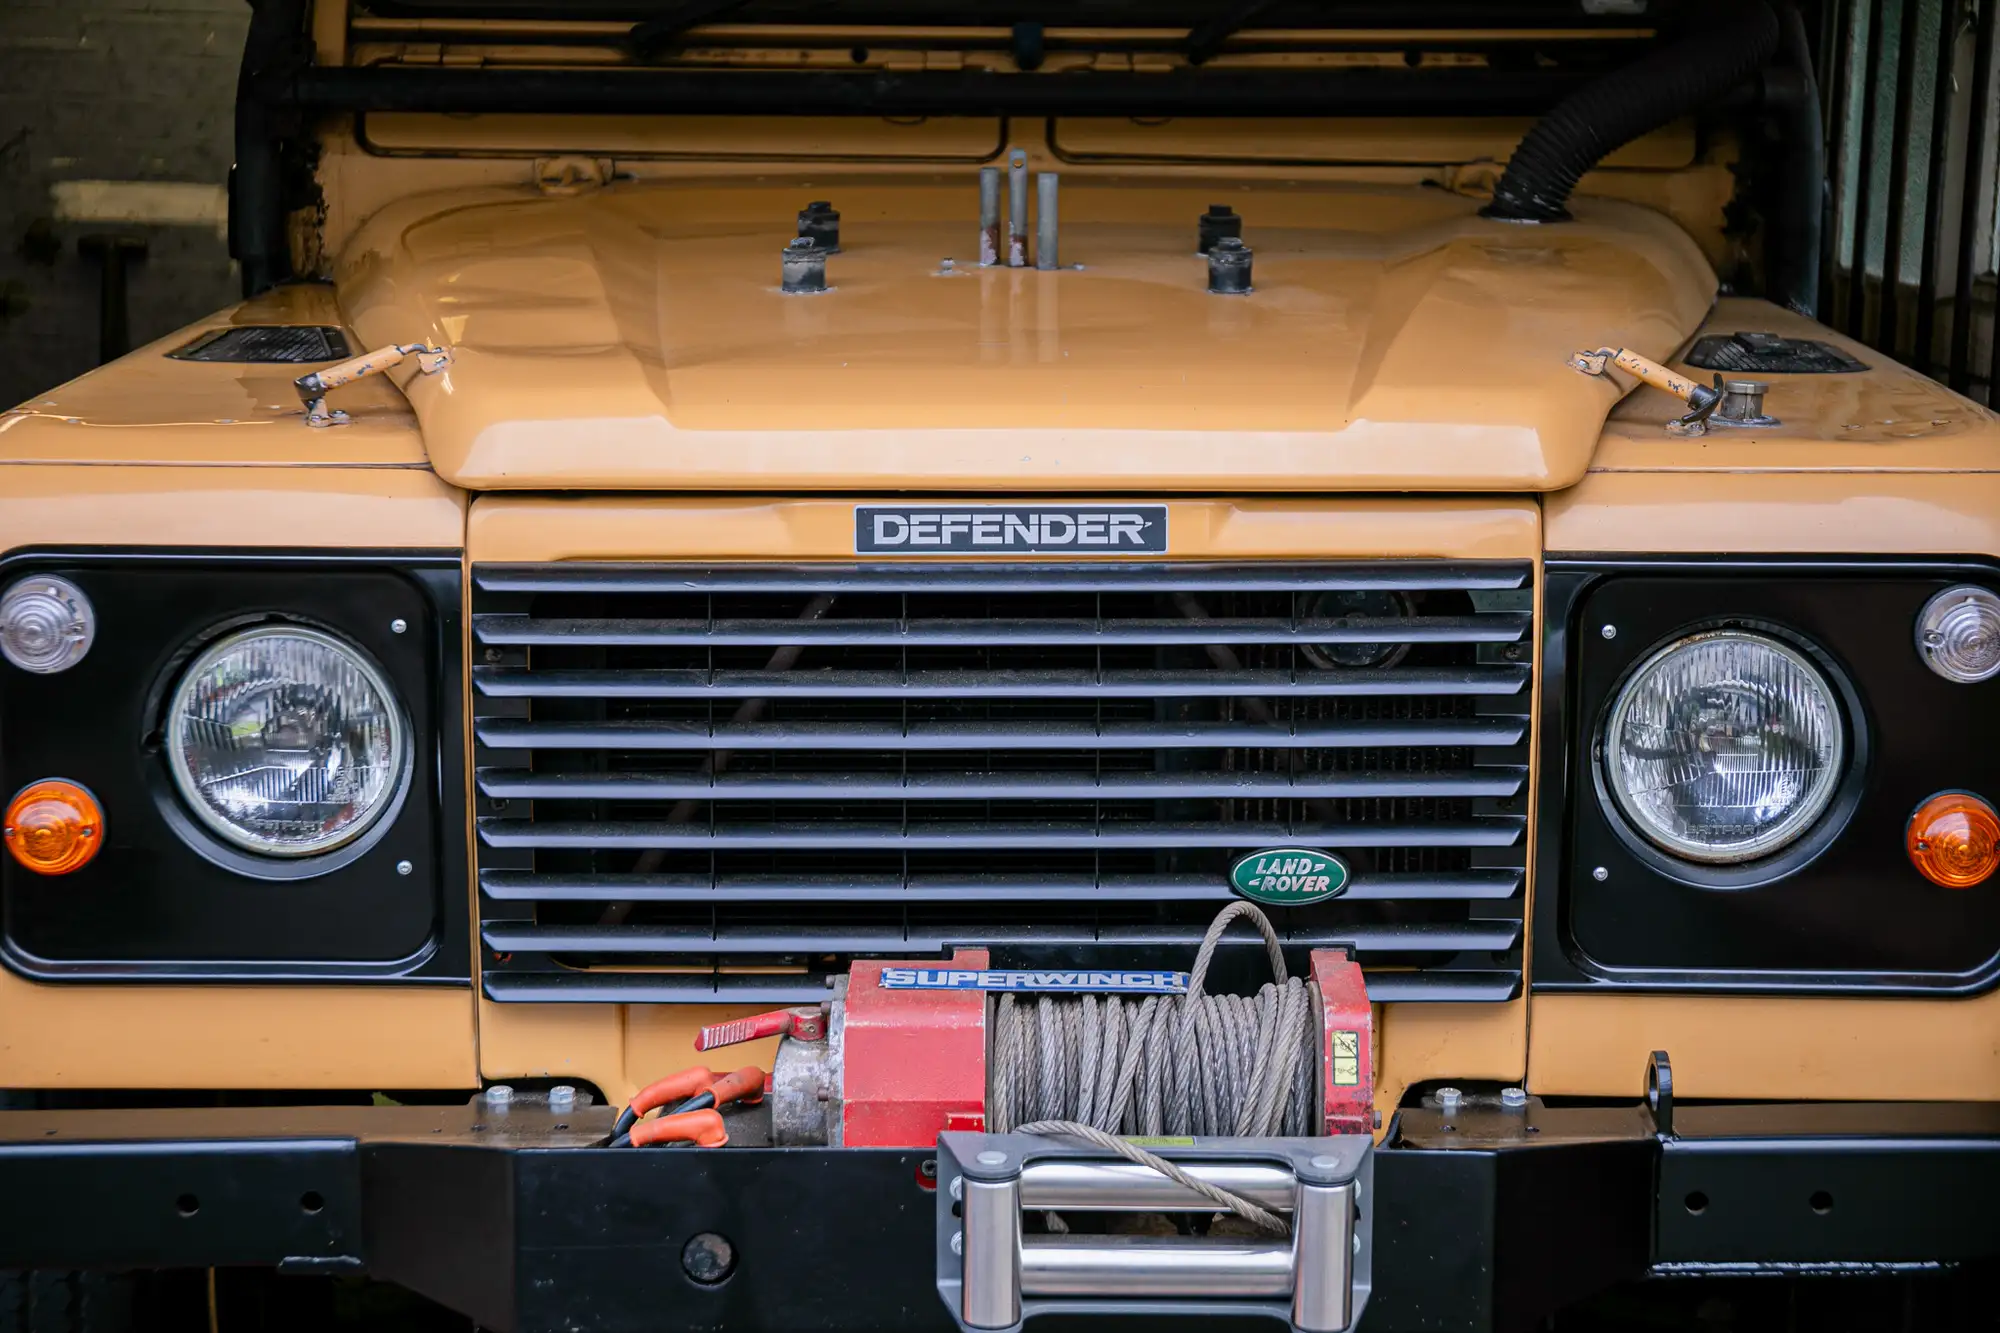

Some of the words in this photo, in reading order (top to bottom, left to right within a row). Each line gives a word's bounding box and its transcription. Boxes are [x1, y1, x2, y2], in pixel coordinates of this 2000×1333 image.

[873, 513, 1146, 545] DEFENDER
[1255, 858, 1313, 875] LAND
[1260, 875, 1331, 892] ROVER
[885, 970, 1184, 988] SUPERWINCH
